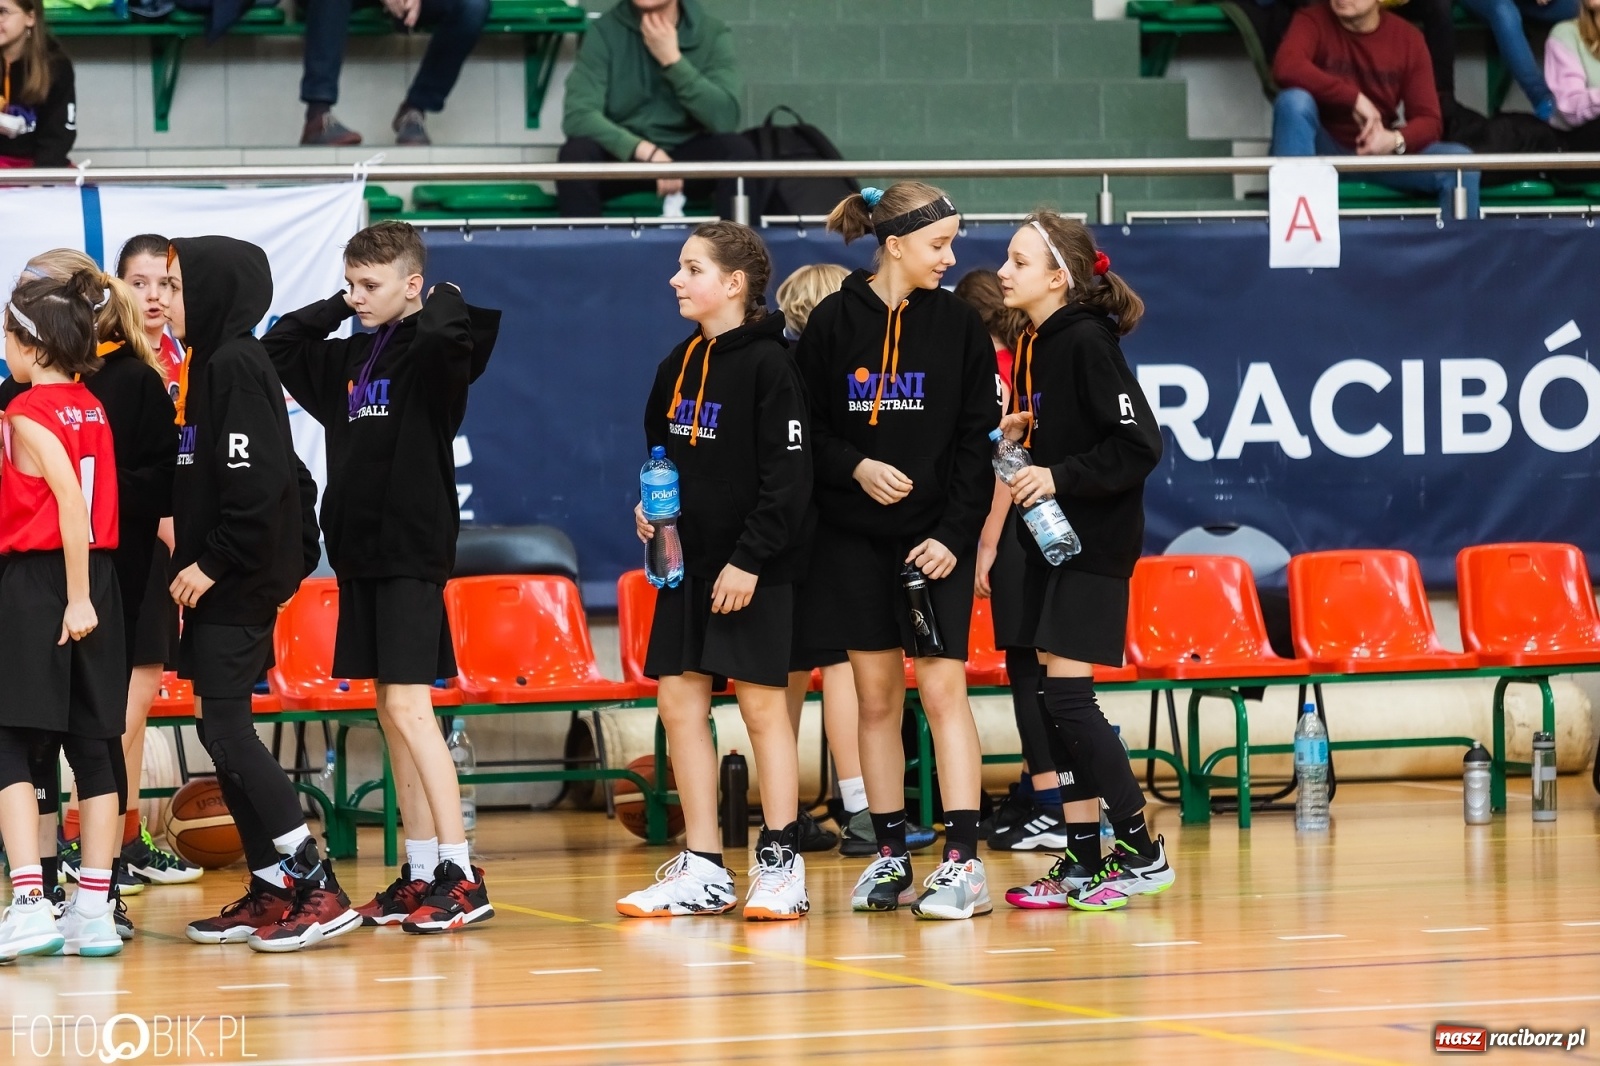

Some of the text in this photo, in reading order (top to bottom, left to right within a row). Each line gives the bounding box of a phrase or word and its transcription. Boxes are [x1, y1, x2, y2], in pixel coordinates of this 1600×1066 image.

[1285, 196, 1323, 243] A
[847, 372, 926, 399] MINI
[1136, 319, 1600, 462] RACIBÓ
[228, 433, 250, 459] R
